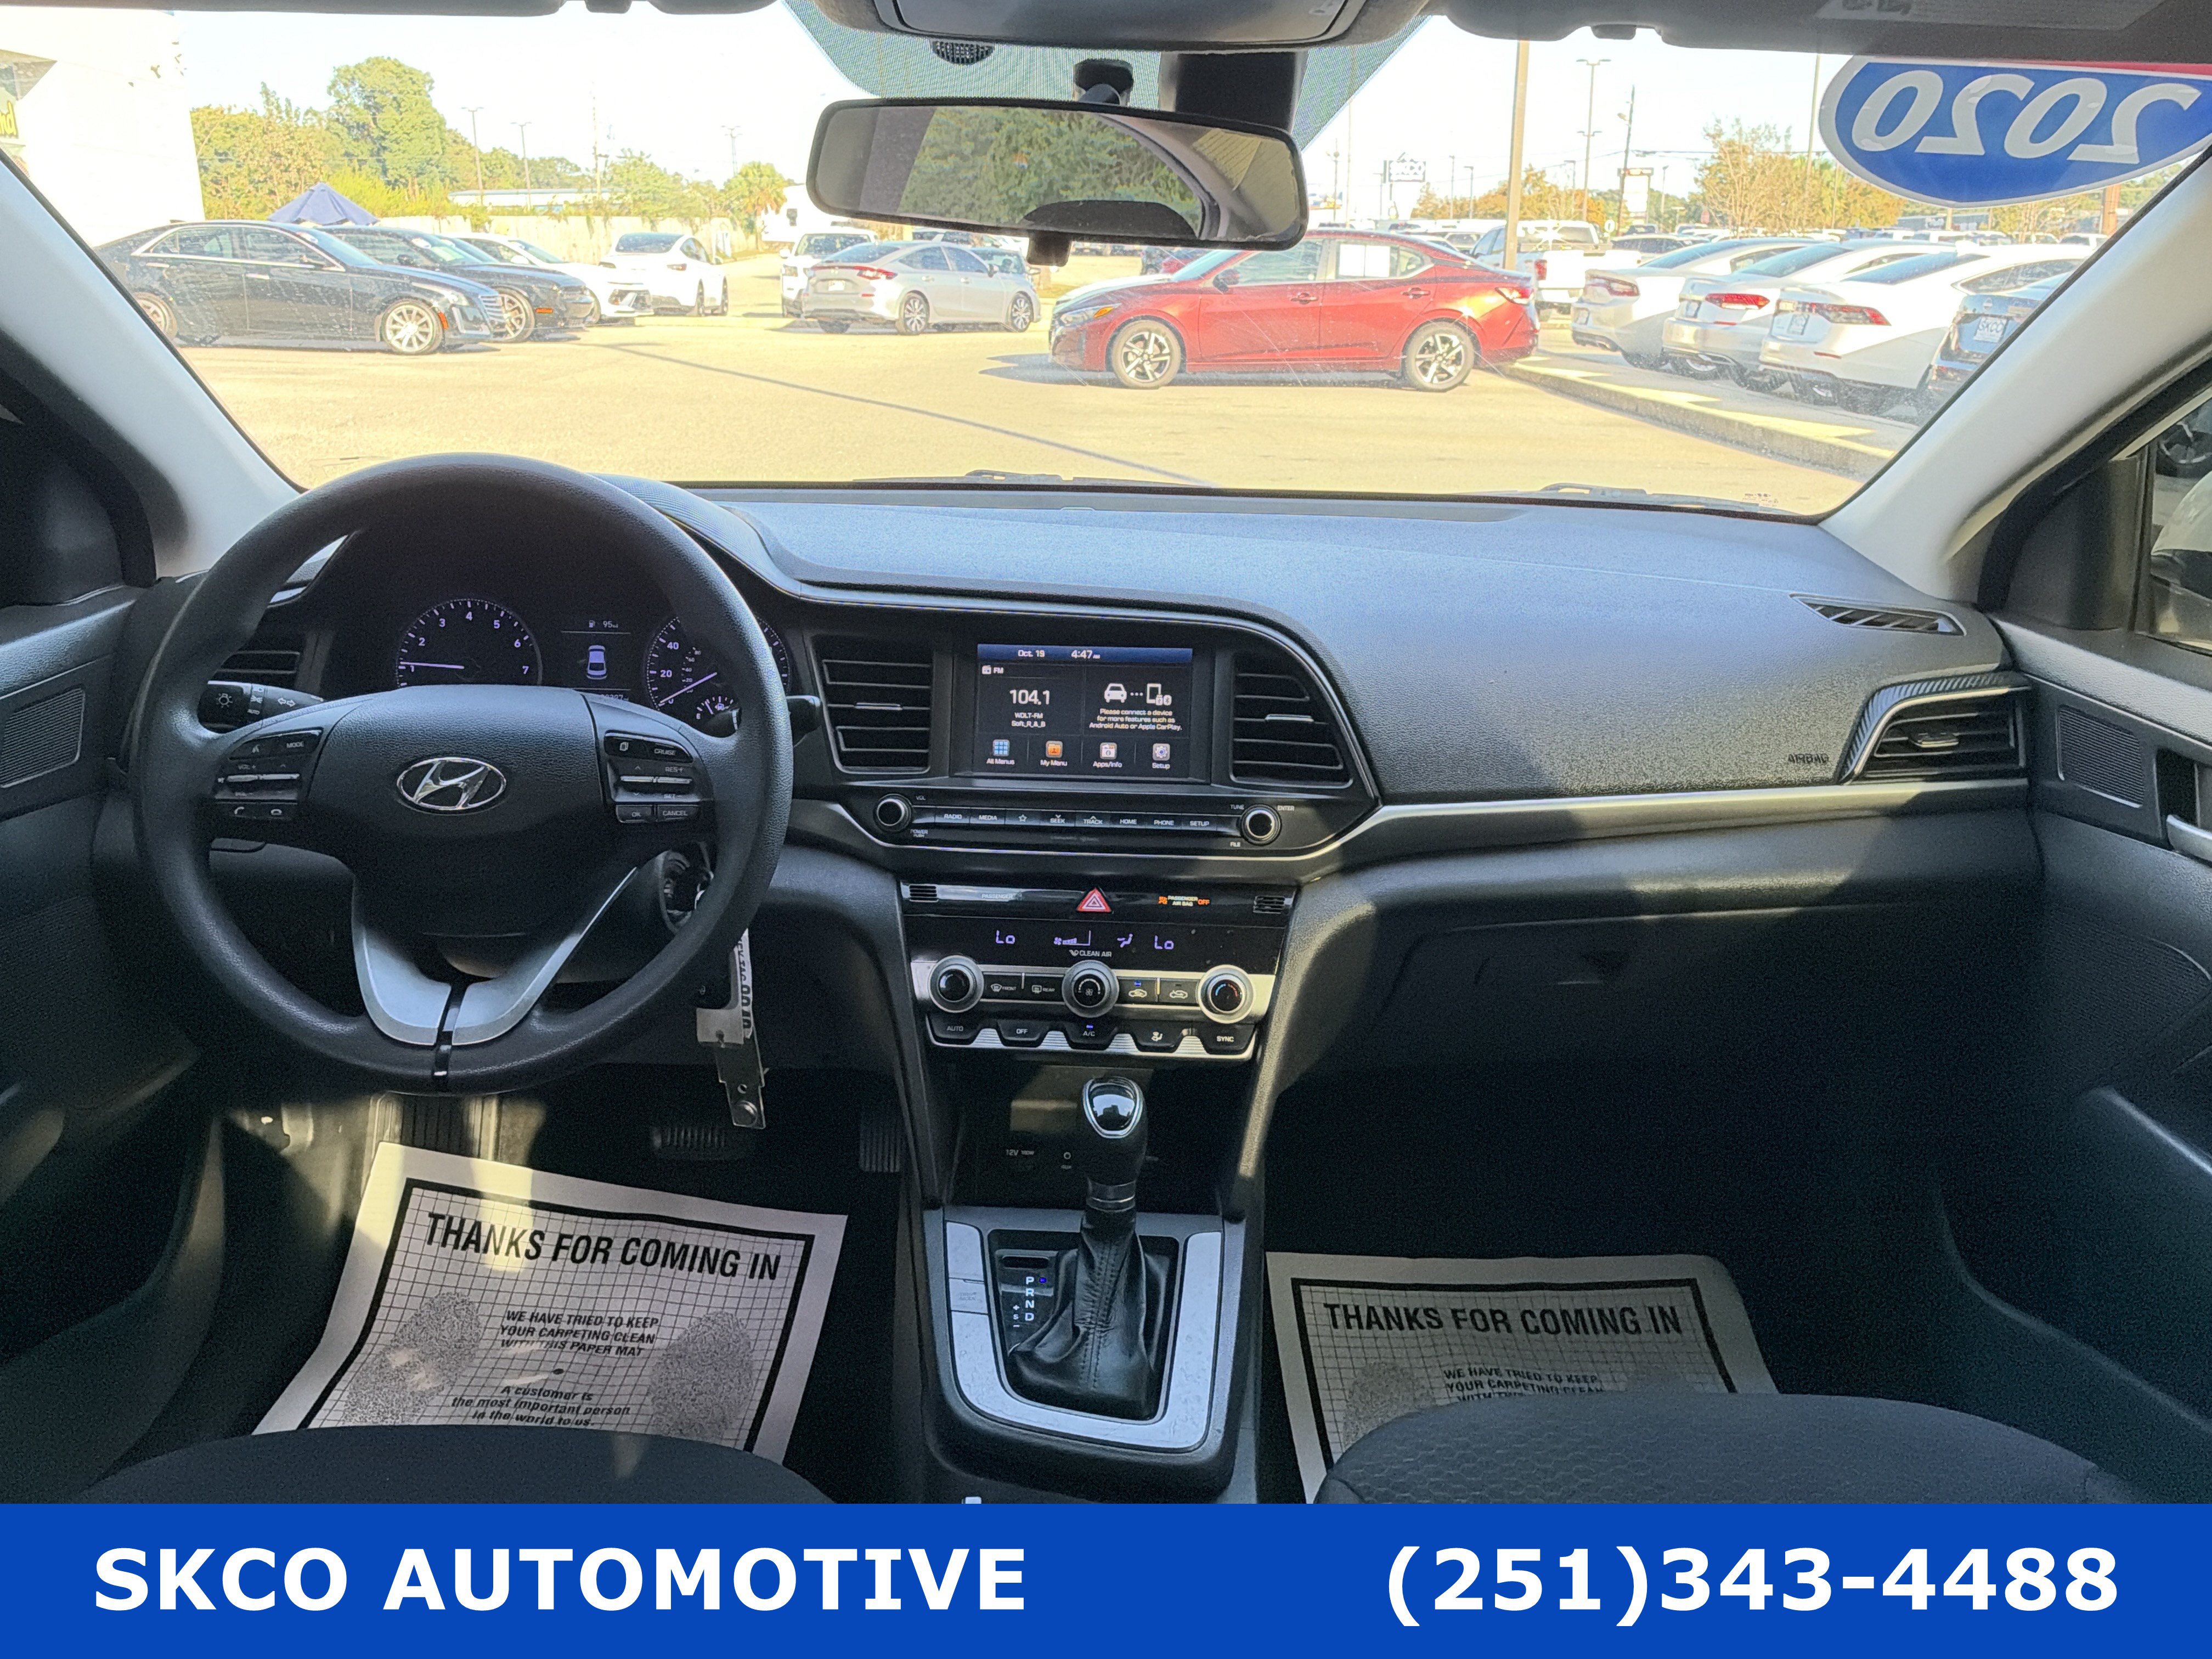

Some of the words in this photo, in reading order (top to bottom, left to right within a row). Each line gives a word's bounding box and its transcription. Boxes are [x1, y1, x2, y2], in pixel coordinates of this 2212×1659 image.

[439, 618, 445, 627] 3
[466, 612, 473, 620] 4
[494, 620, 500, 629] 5
[419, 637, 425, 646] 2
[514, 639, 521, 648] 6
[1071, 650, 1092, 659] 4:47
[522, 665, 529, 674] 7
[1009, 690, 1050, 705] 104.1
[996, 930, 1015, 944] Lo
[1154, 935, 1174, 950] Lo
[427, 1212, 545, 1261] THANKS
[552, 1233, 613, 1265] FOR
[620, 1237, 741, 1278] COMING
[749, 1253, 781, 1281] IN
[1025, 1288, 1035, 1296] R
[1025, 1300, 1035, 1308] N
[506, 1310, 527, 1322] WE
[529, 1312, 563, 1325] HAVE
[566, 1314, 603, 1327] TRIED
[607, 1316, 623, 1327] TO
[626, 1317, 659, 1329] KEEP
[1025, 1313, 1035, 1322] D
[1323, 1302, 1443, 1331] THANKS
[1450, 1307, 1514, 1335] FOR
[1522, 1306, 1642, 1336] COMING
[1649, 1306, 1682, 1334] IN
[500, 1325, 536, 1338] YOUR
[538, 1327, 611, 1341] CARPETING
[614, 1331, 656, 1344] CLEAN
[569, 1341, 611, 1355] PAPER
[615, 1345, 645, 1357] MAT
[1443, 1368, 1466, 1380] WE
[1468, 1367, 1502, 1378] HAVE
[1505, 1369, 1543, 1381] TRIED
[1548, 1373, 1563, 1383] TO
[1566, 1374, 1598, 1384] KEEP
[500, 1386, 511, 1395] A
[515, 1385, 577, 1399] customer
[581, 1392, 594, 1401] is
[1446, 1380, 1484, 1393] YOUR
[1488, 1379, 1560, 1395] CARPETING
[452, 1396, 471, 1407] the
[477, 1398, 512, 1407] most
[514, 1398, 580, 1414] important
[583, 1406, 631, 1415] person
[472, 1409, 486, 1420] in
[489, 1410, 511, 1420] the
[515, 1413, 555, 1426] world
[556, 1416, 571, 1426] to
[574, 1417, 595, 1426] us.
